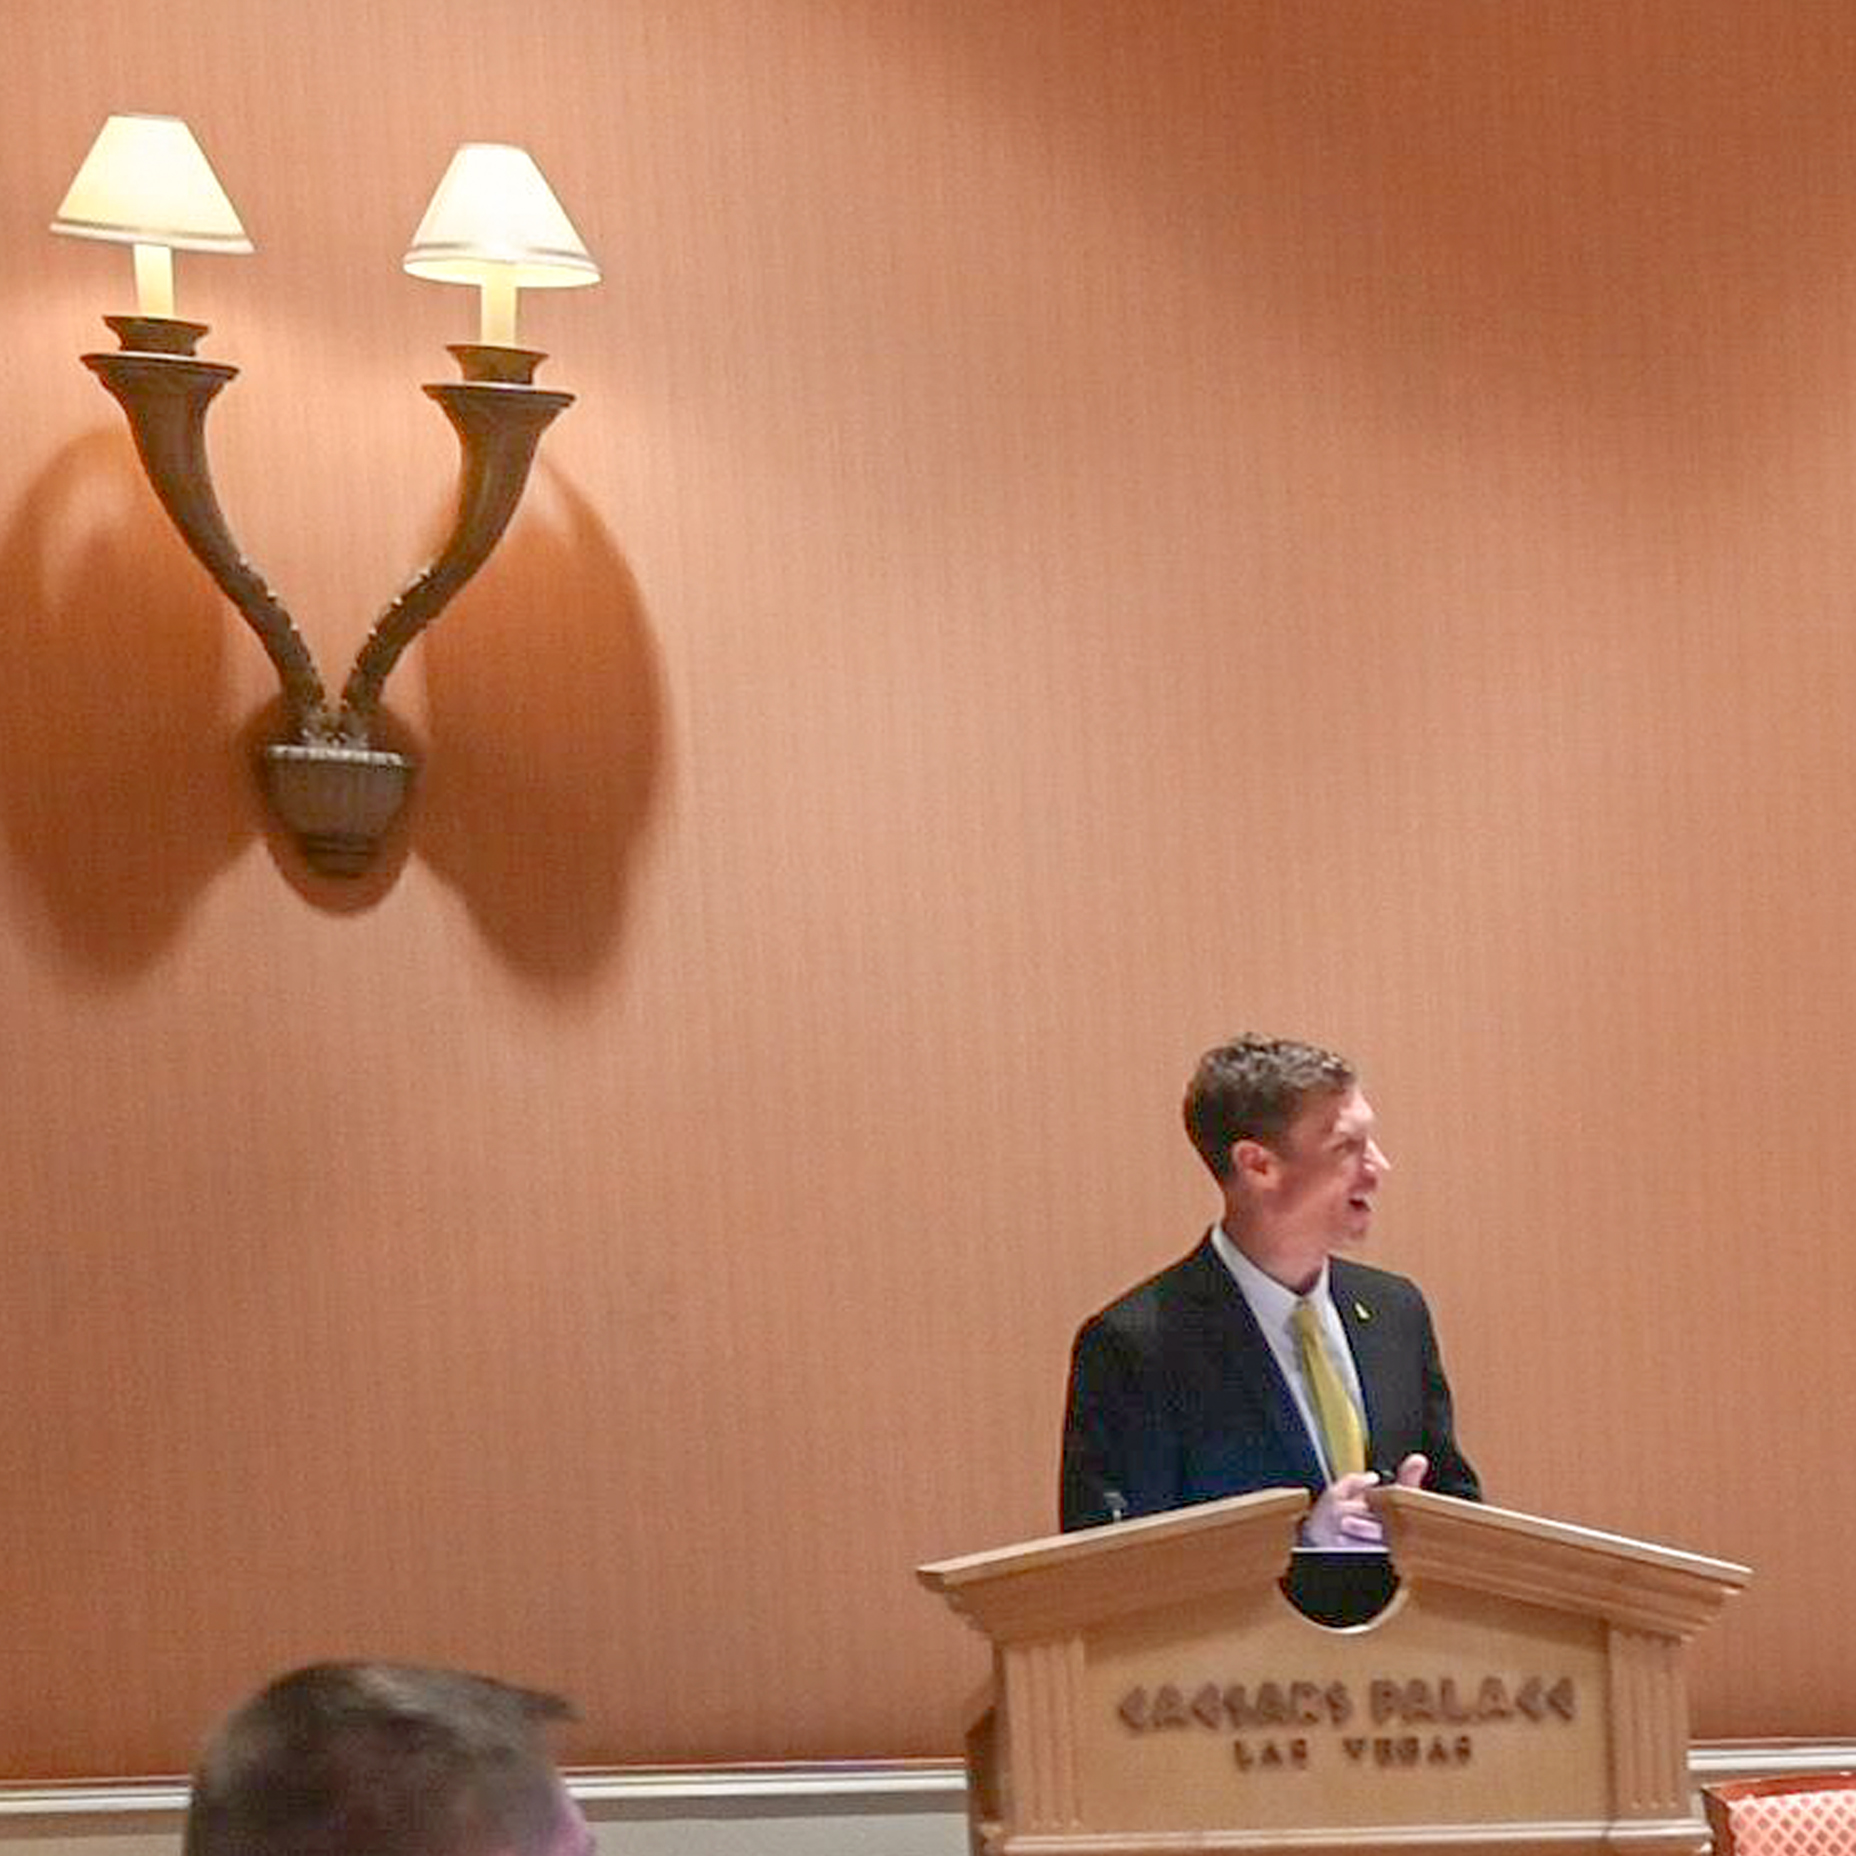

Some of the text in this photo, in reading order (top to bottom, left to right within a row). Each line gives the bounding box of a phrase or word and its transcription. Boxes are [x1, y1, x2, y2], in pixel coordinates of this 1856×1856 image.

[1116, 1677, 1576, 1737] CAESARS PALACE
[1232, 1735, 1474, 1772] LAS VEGAS
